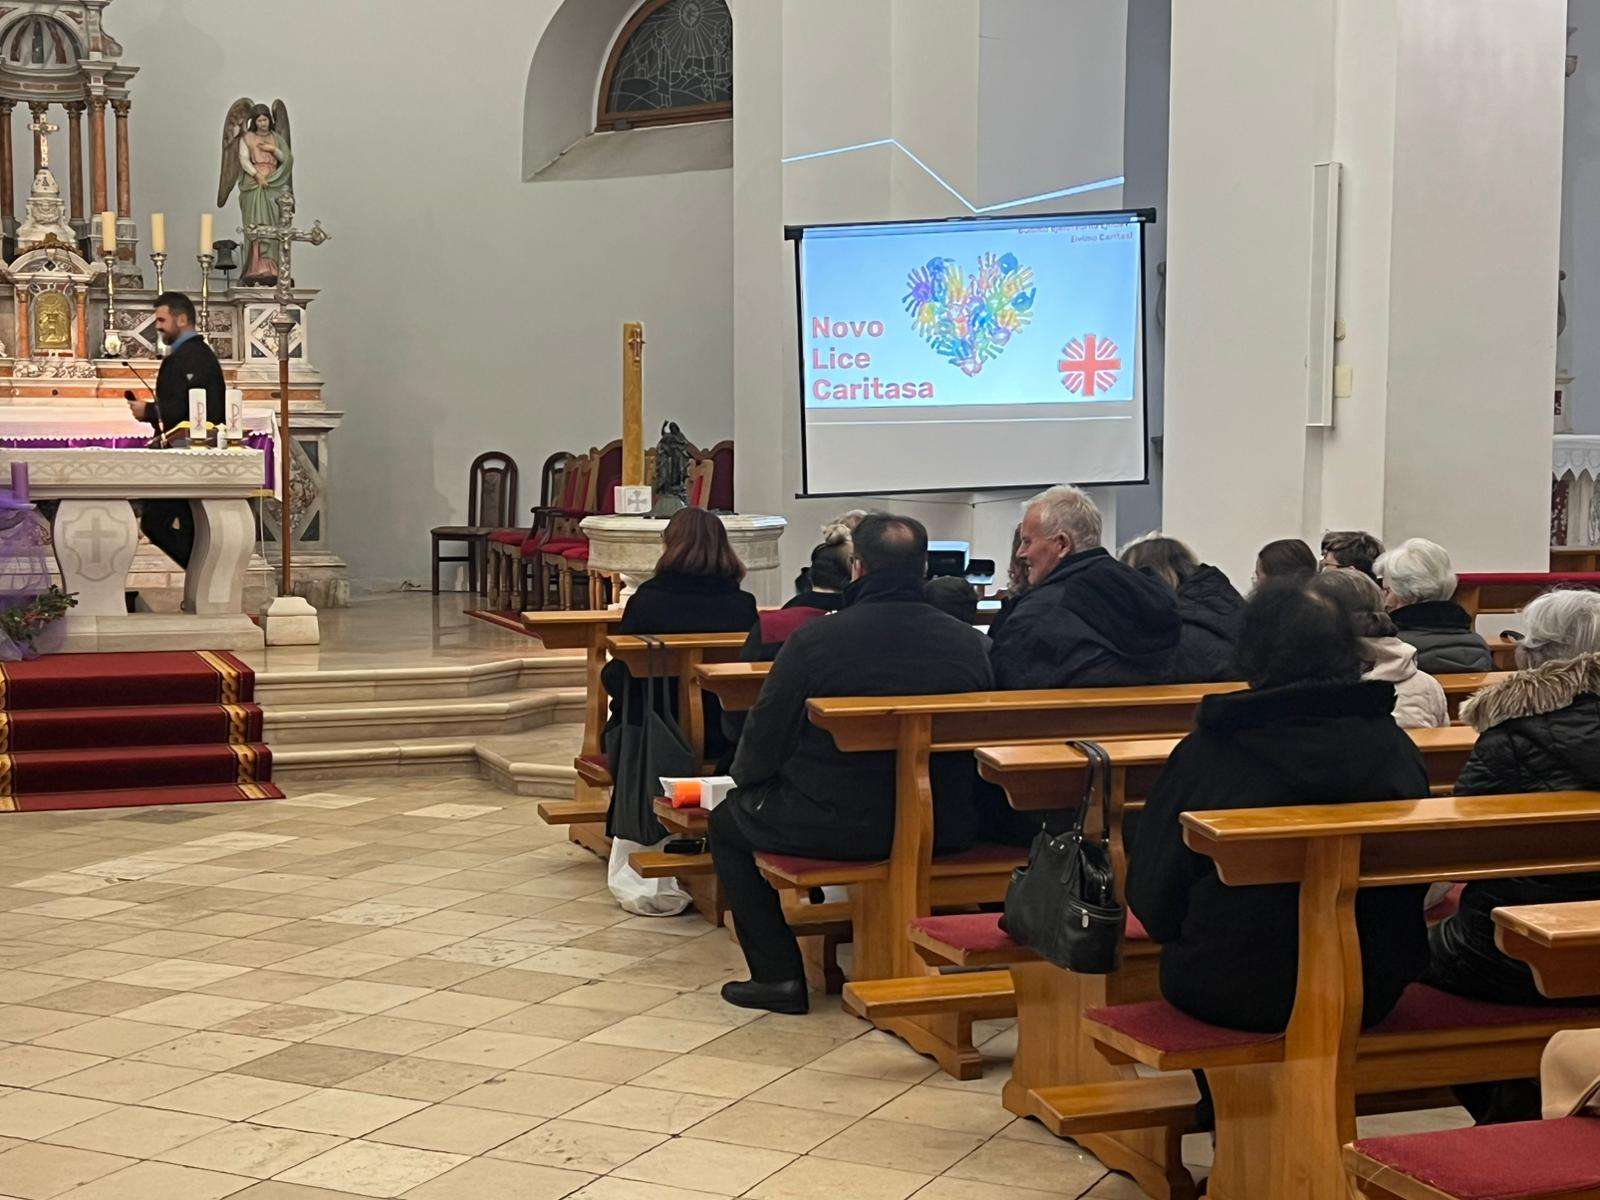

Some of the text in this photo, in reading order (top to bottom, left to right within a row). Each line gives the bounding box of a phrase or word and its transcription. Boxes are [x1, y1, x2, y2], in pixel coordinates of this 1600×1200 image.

[812, 316, 884, 338] Novo
[812, 347, 871, 369] Lice
[812, 377, 934, 400] Caritasa
